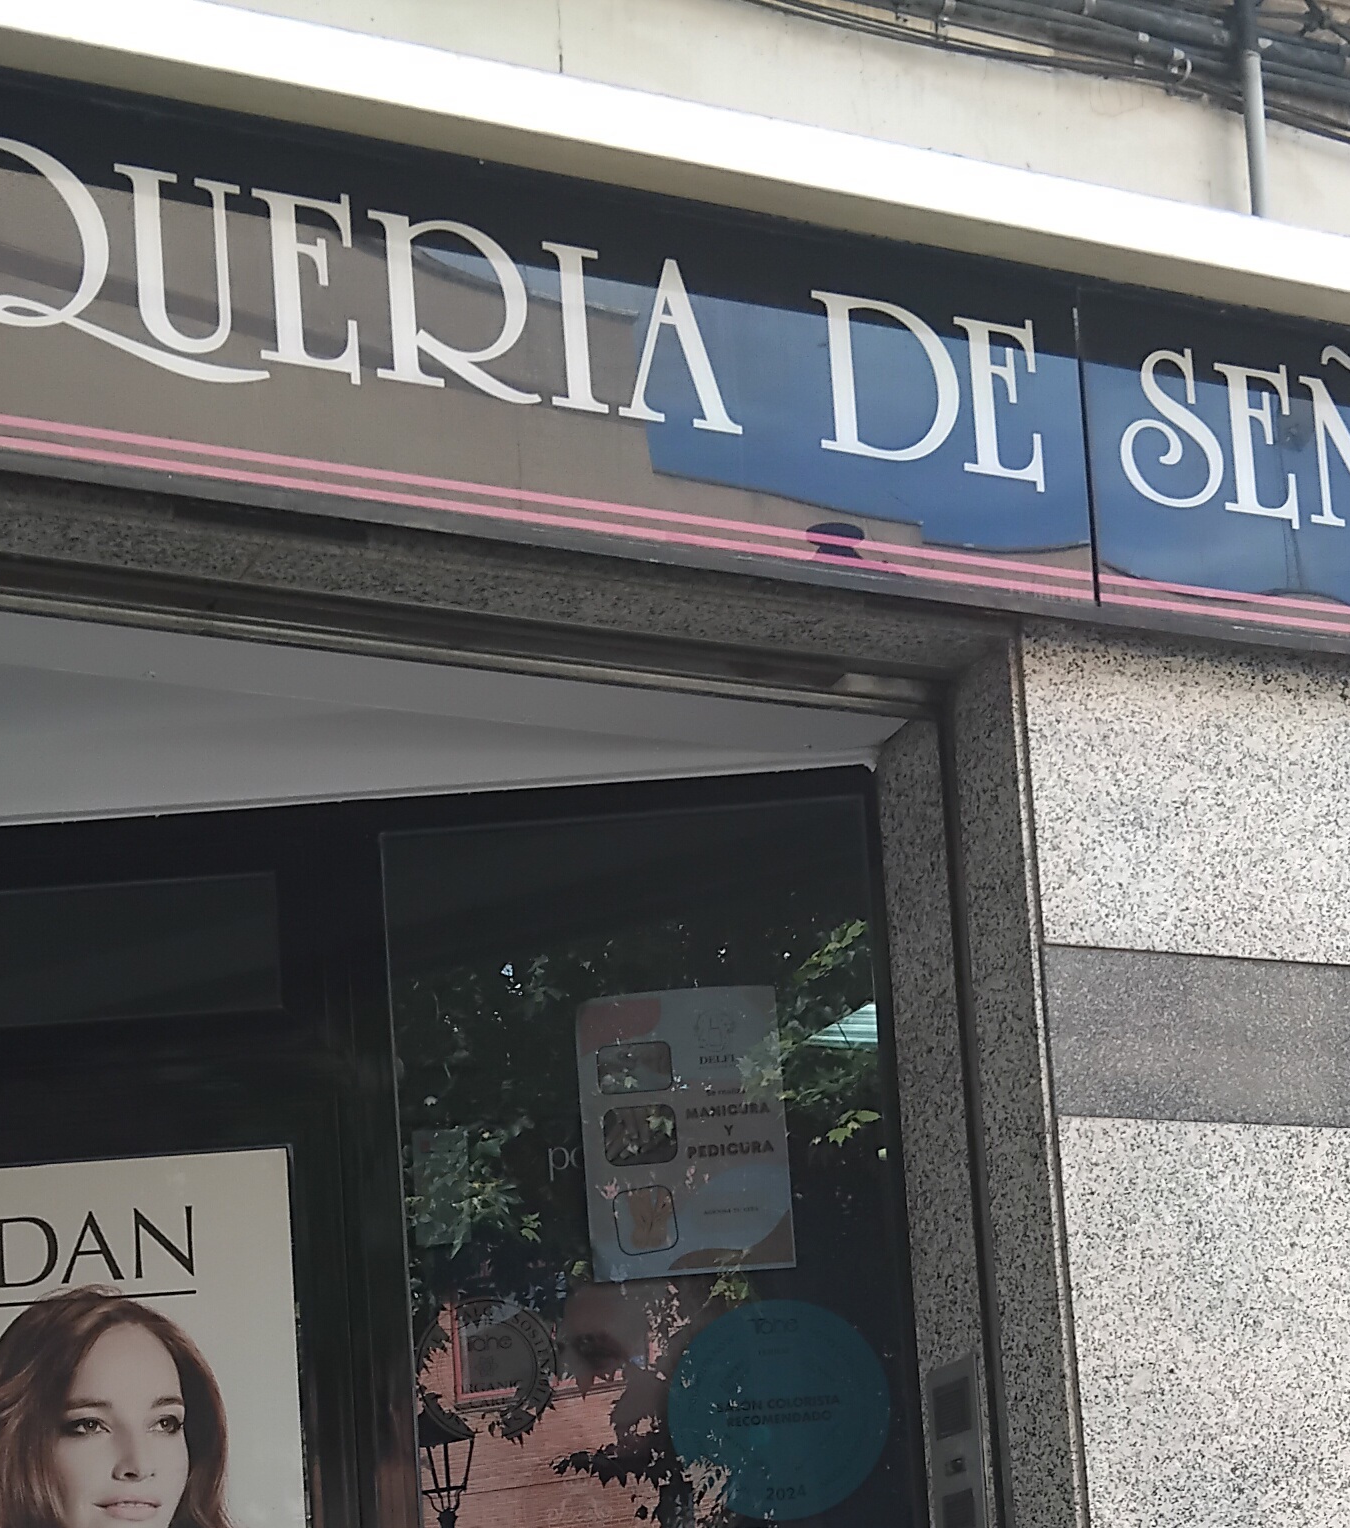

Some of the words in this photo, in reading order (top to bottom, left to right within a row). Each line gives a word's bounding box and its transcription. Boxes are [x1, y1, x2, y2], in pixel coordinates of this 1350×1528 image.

[810, 289, 1044, 493] DE
[685, 1102, 770, 1119] MANICURA
[724, 1124, 734, 1137] Y
[687, 1140, 774, 1159] PEDICURA
[767, 1395, 841, 1410] COLORISTA
[726, 1410, 833, 1428] RECOMENDADO
[766, 1485, 807, 1501] 2024
